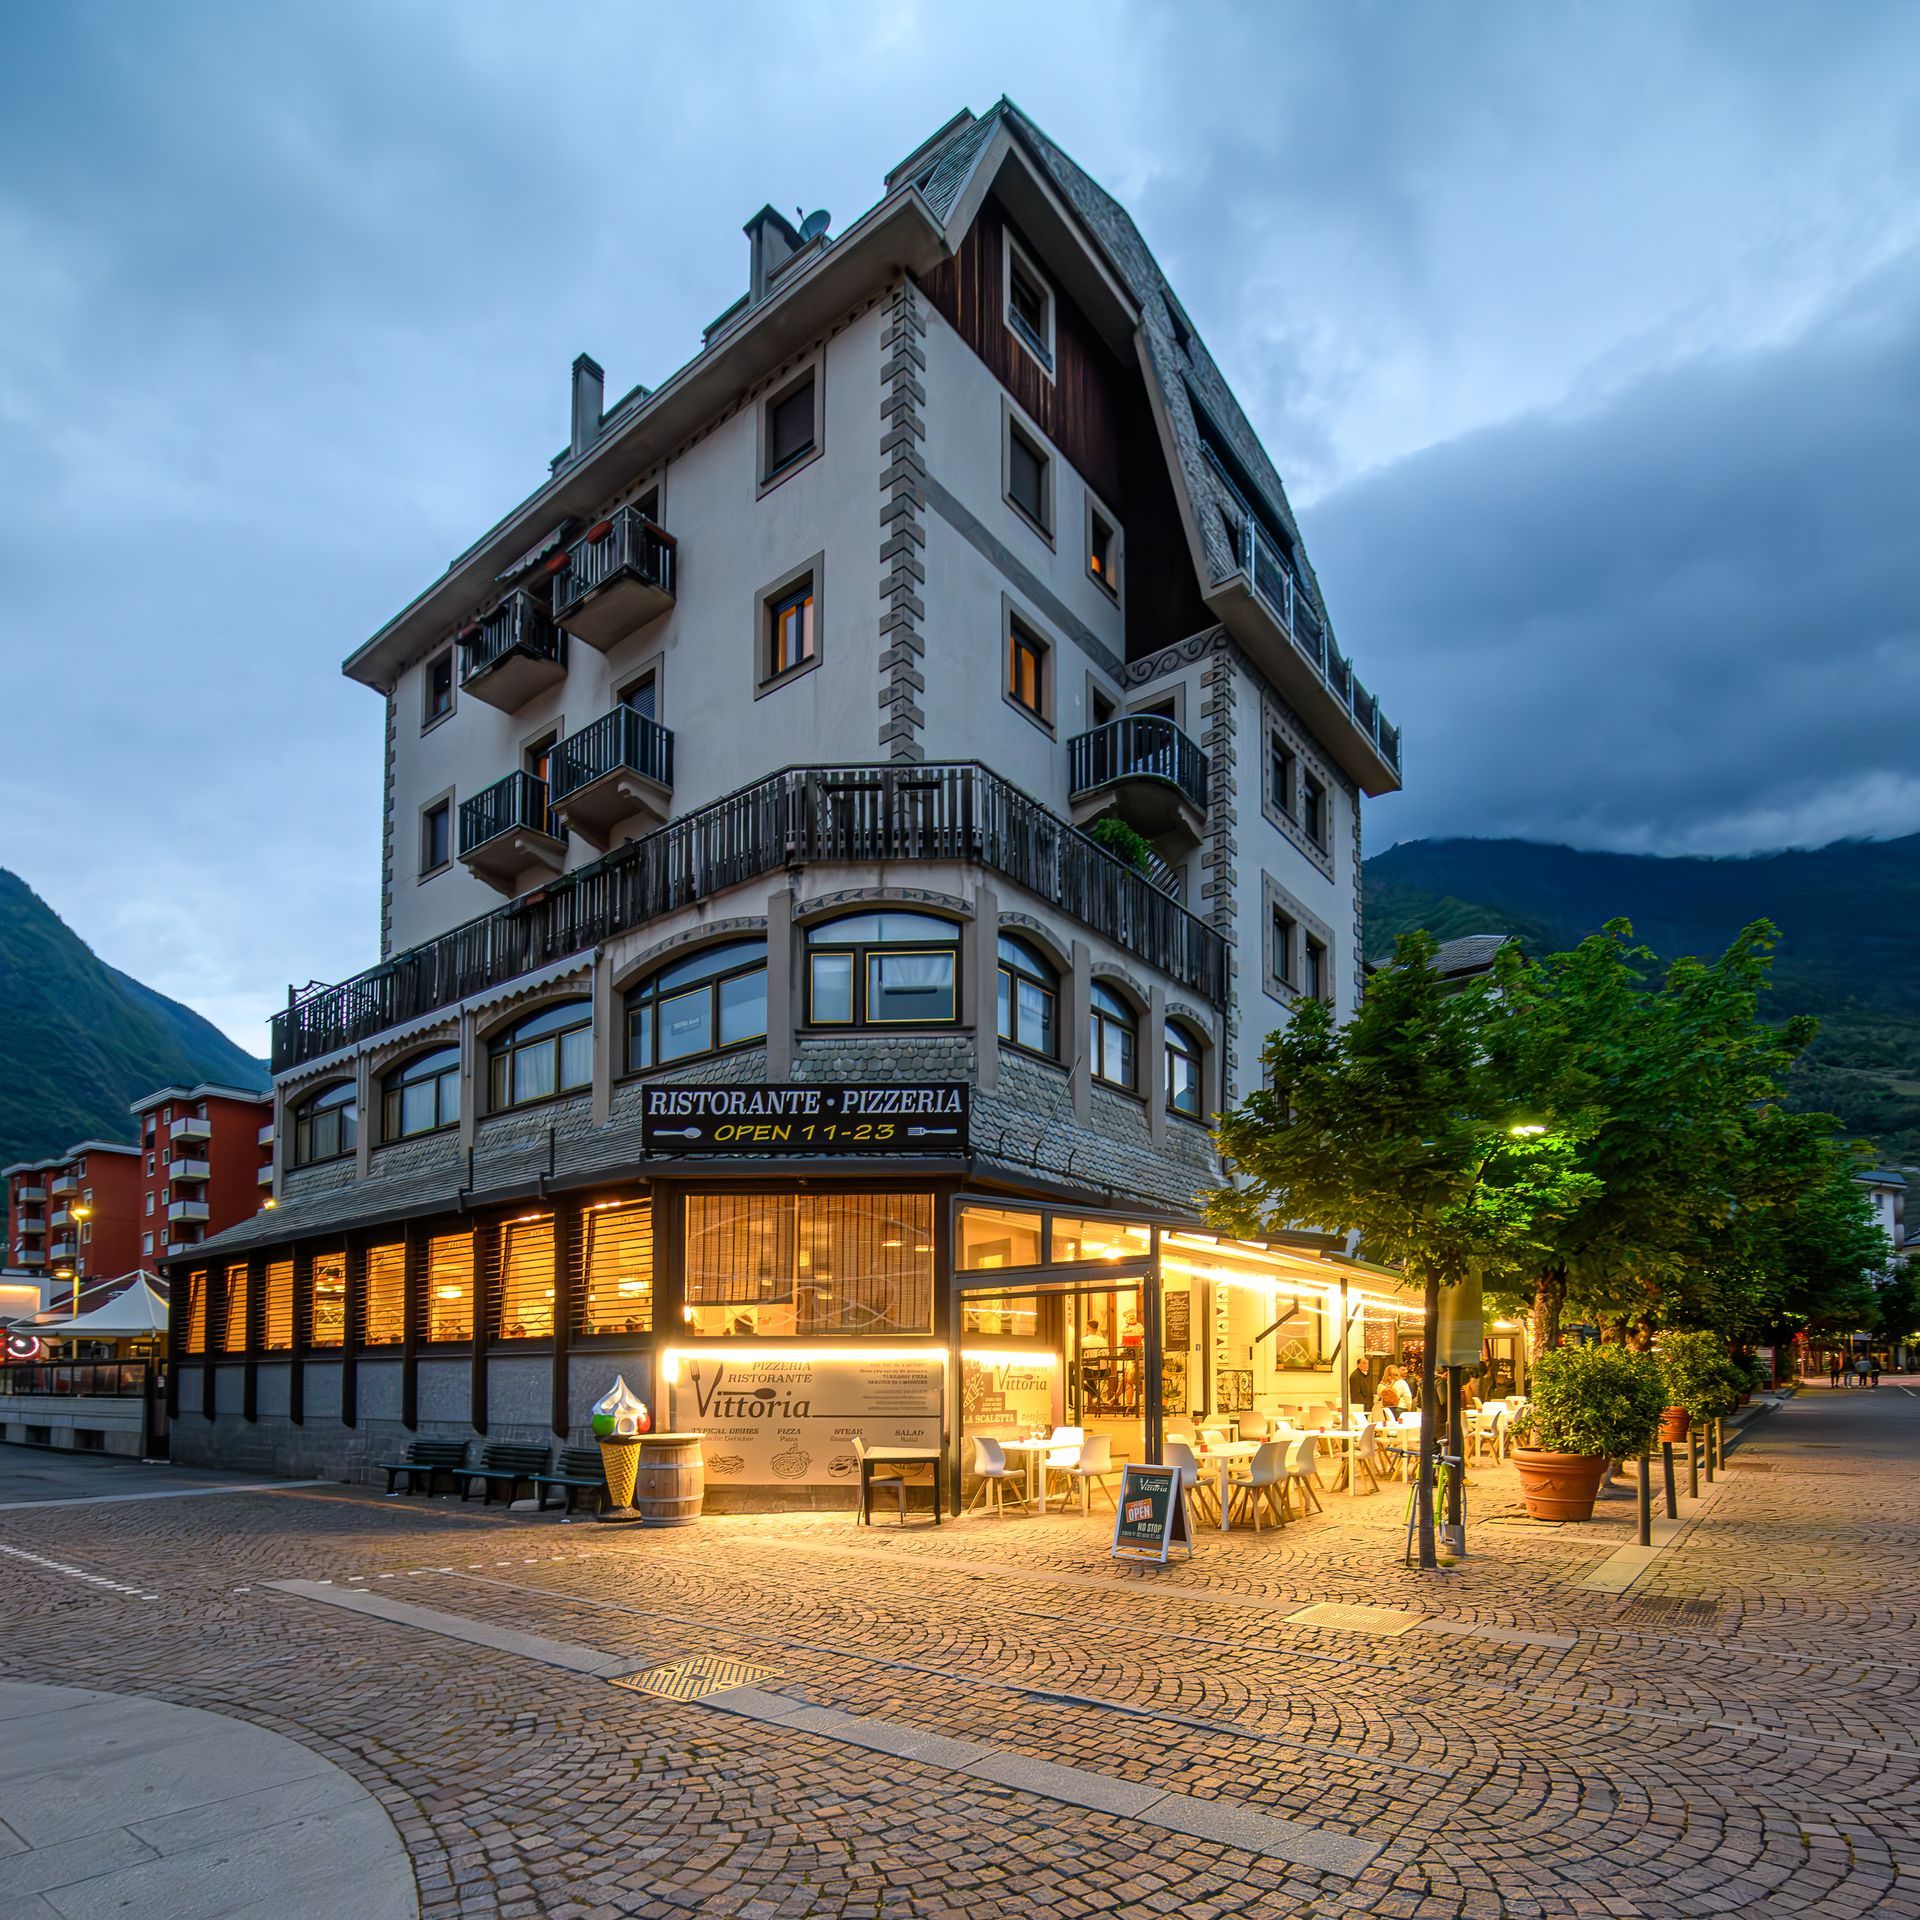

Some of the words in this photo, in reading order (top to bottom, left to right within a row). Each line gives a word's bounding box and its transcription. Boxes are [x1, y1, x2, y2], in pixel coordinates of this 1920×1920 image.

[648, 1091, 820, 1116] RISTORANTE
[840, 1089, 963, 1114] PIZZERIA
[714, 1124, 792, 1141] OPEN
[752, 1361, 811, 1371] PIZZERIA
[728, 1374, 813, 1383] RISTORANTE
[996, 1362, 1047, 1390] Vittoria
[690, 1360, 812, 1419] Vittoria
[976, 1413, 1014, 1424] SCALETTA
[1128, 1504, 1150, 1521] OPEN
[1137, 1523, 1146, 1531] NO
[1147, 1524, 1162, 1533] STOP
